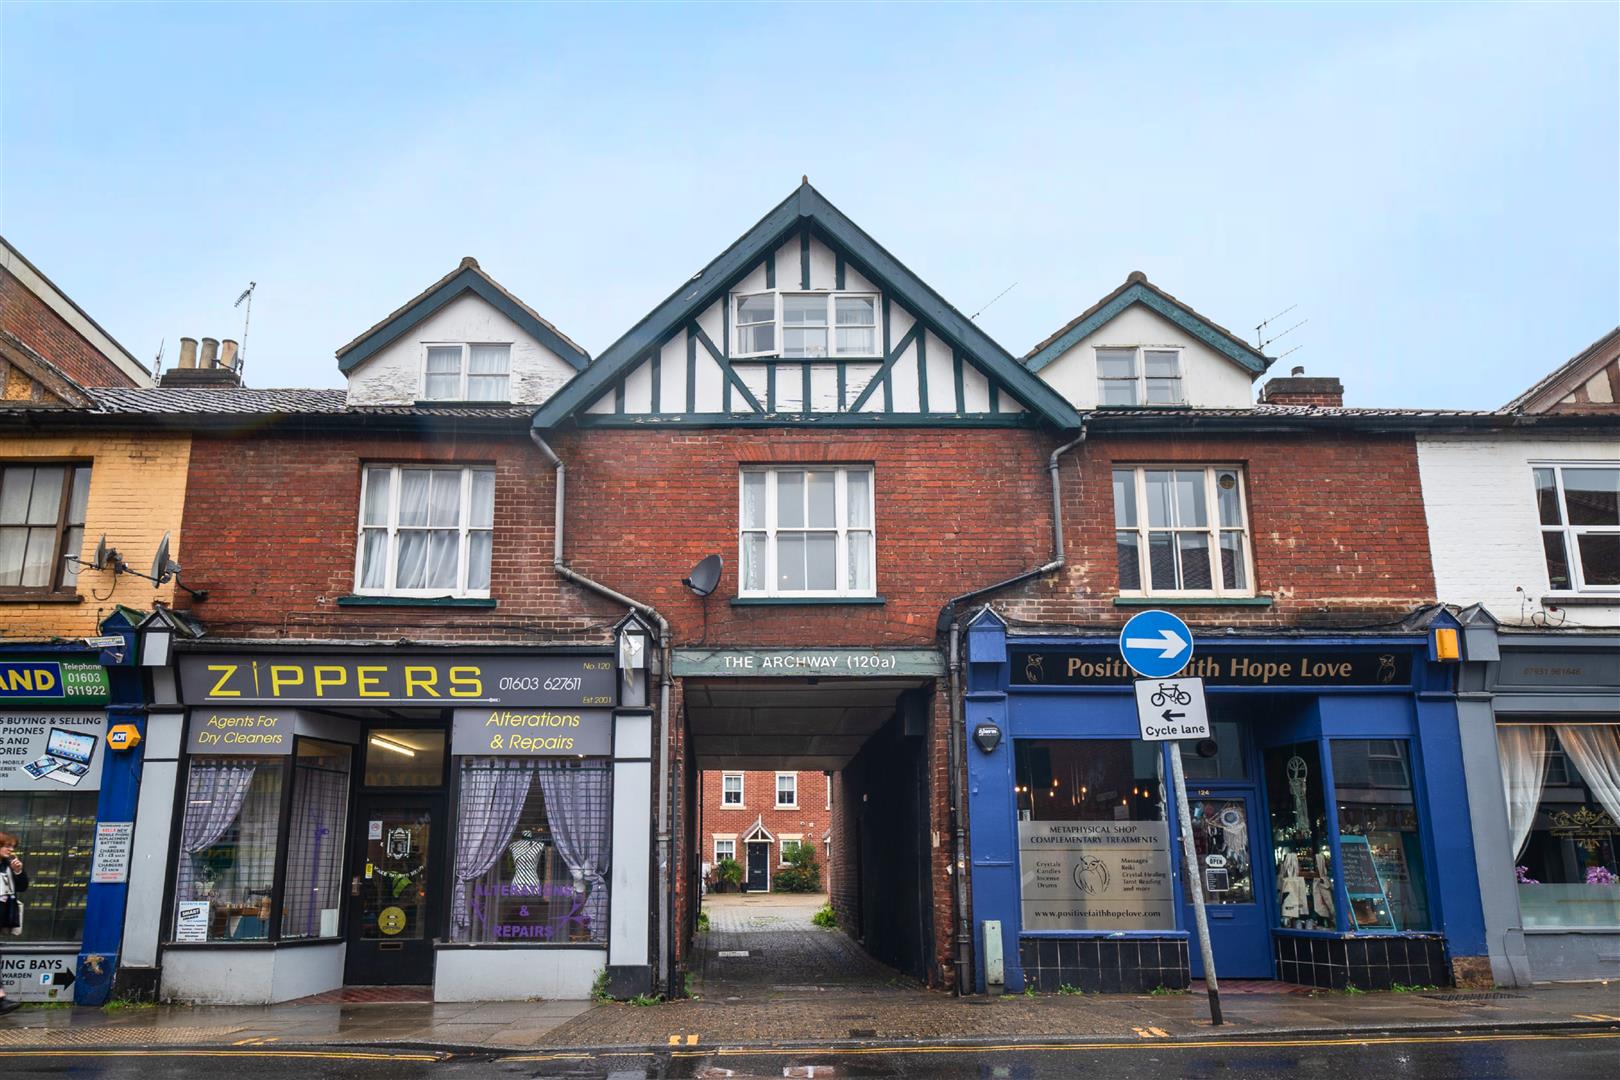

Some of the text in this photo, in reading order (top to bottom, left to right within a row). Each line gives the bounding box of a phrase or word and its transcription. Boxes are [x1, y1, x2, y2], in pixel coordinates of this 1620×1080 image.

[63, 663, 102, 671] Telephone
[723, 655, 896, 670] THE ARCHWAY (120a)
[1067, 655, 1353, 684] Positi ith Hope Love
[67, 673, 101, 683] 01603
[499, 677, 581, 690] 01603 627611
[67, 685, 106, 695] 611922
[7, 717, 46, 725] BUYING
[49, 717, 57, 725] &
[59, 717, 102, 725] SELLING
[207, 715, 279, 729] Agents For
[485, 711, 581, 728] Alterations
[2, 727, 45, 735] PHONES
[112, 732, 127, 741] ADT
[1145, 724, 1206, 738] Cycle lane
[7, 737, 30, 745] AND
[198, 731, 283, 745] Dry Cleaners
[490, 734, 575, 752] & Repairs
[1030, 836, 1159, 844] COMPLEMENTARY TREATMENTS
[519, 904, 530, 917] &
[494, 924, 553, 938] REPAIRS
[29, 960, 62, 970] BAYS
[42, 975, 50, 984] P
